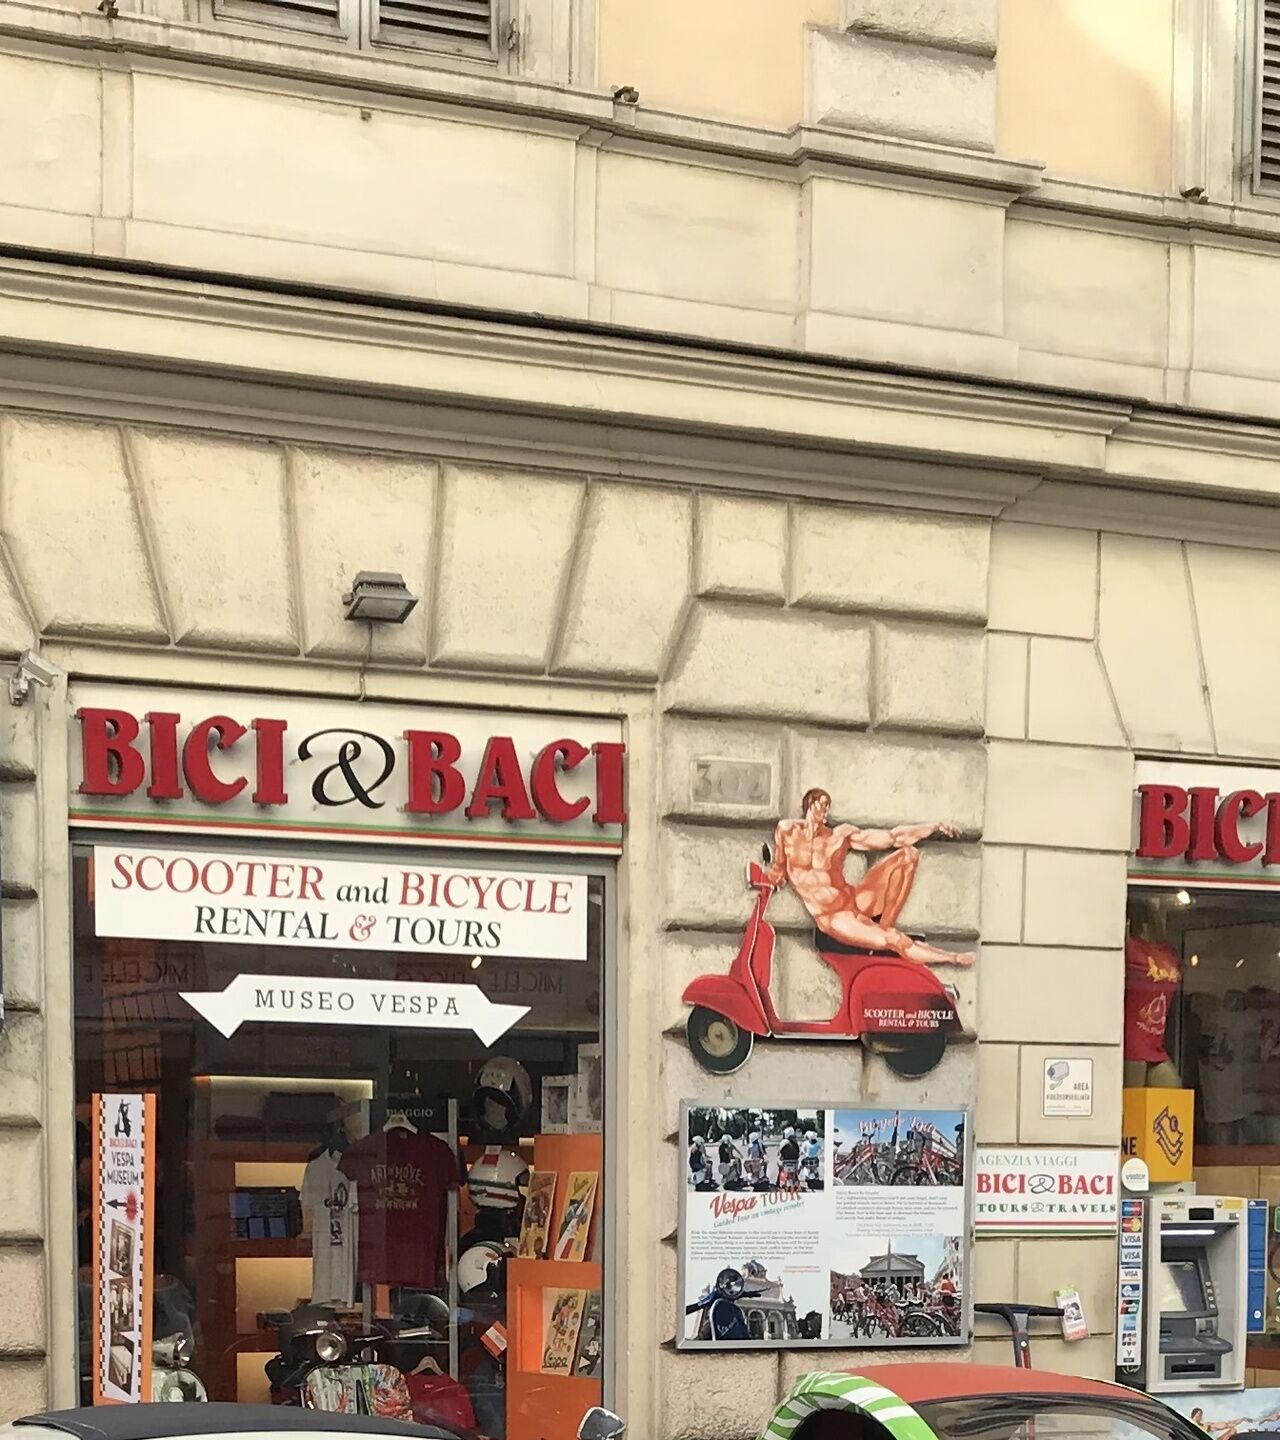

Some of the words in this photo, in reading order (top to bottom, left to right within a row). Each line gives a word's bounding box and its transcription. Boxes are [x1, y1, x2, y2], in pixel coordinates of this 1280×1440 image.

[76, 707, 289, 806] BICI
[297, 728, 396, 809] &
[403, 729, 627, 825] BACI
[111, 854, 324, 901] SCOOTER
[336, 877, 388, 905] and
[399, 871, 572, 915] BICYCLE
[193, 907, 339, 942] RENTAL
[348, 914, 376, 942] &
[386, 915, 501, 949] TOURS
[254, 988, 354, 1012] MUSEO
[371, 993, 461, 1016] VESPA
[863, 1008, 905, 1019] SCOOTER
[917, 1009, 955, 1021] BICYCLE
[878, 1019, 907, 1027] RENTAL
[916, 1019, 940, 1028] TOURS
[111, 1151, 135, 1167] VESPA
[977, 1155, 1032, 1167] AGENZIA
[1034, 1156, 1078, 1167] VIAGGI
[107, 1170, 139, 1185] MUSEUM
[976, 1173, 1026, 1194] BICI
[1028, 1174, 1055, 1194] &
[1058, 1175, 1114, 1195] BACI
[710, 1193, 758, 1220] Vespa
[976, 1203, 1028, 1213] TOURS
[1046, 1203, 1116, 1213] TRAVELS
[1123, 1251, 1140, 1260] VISA
